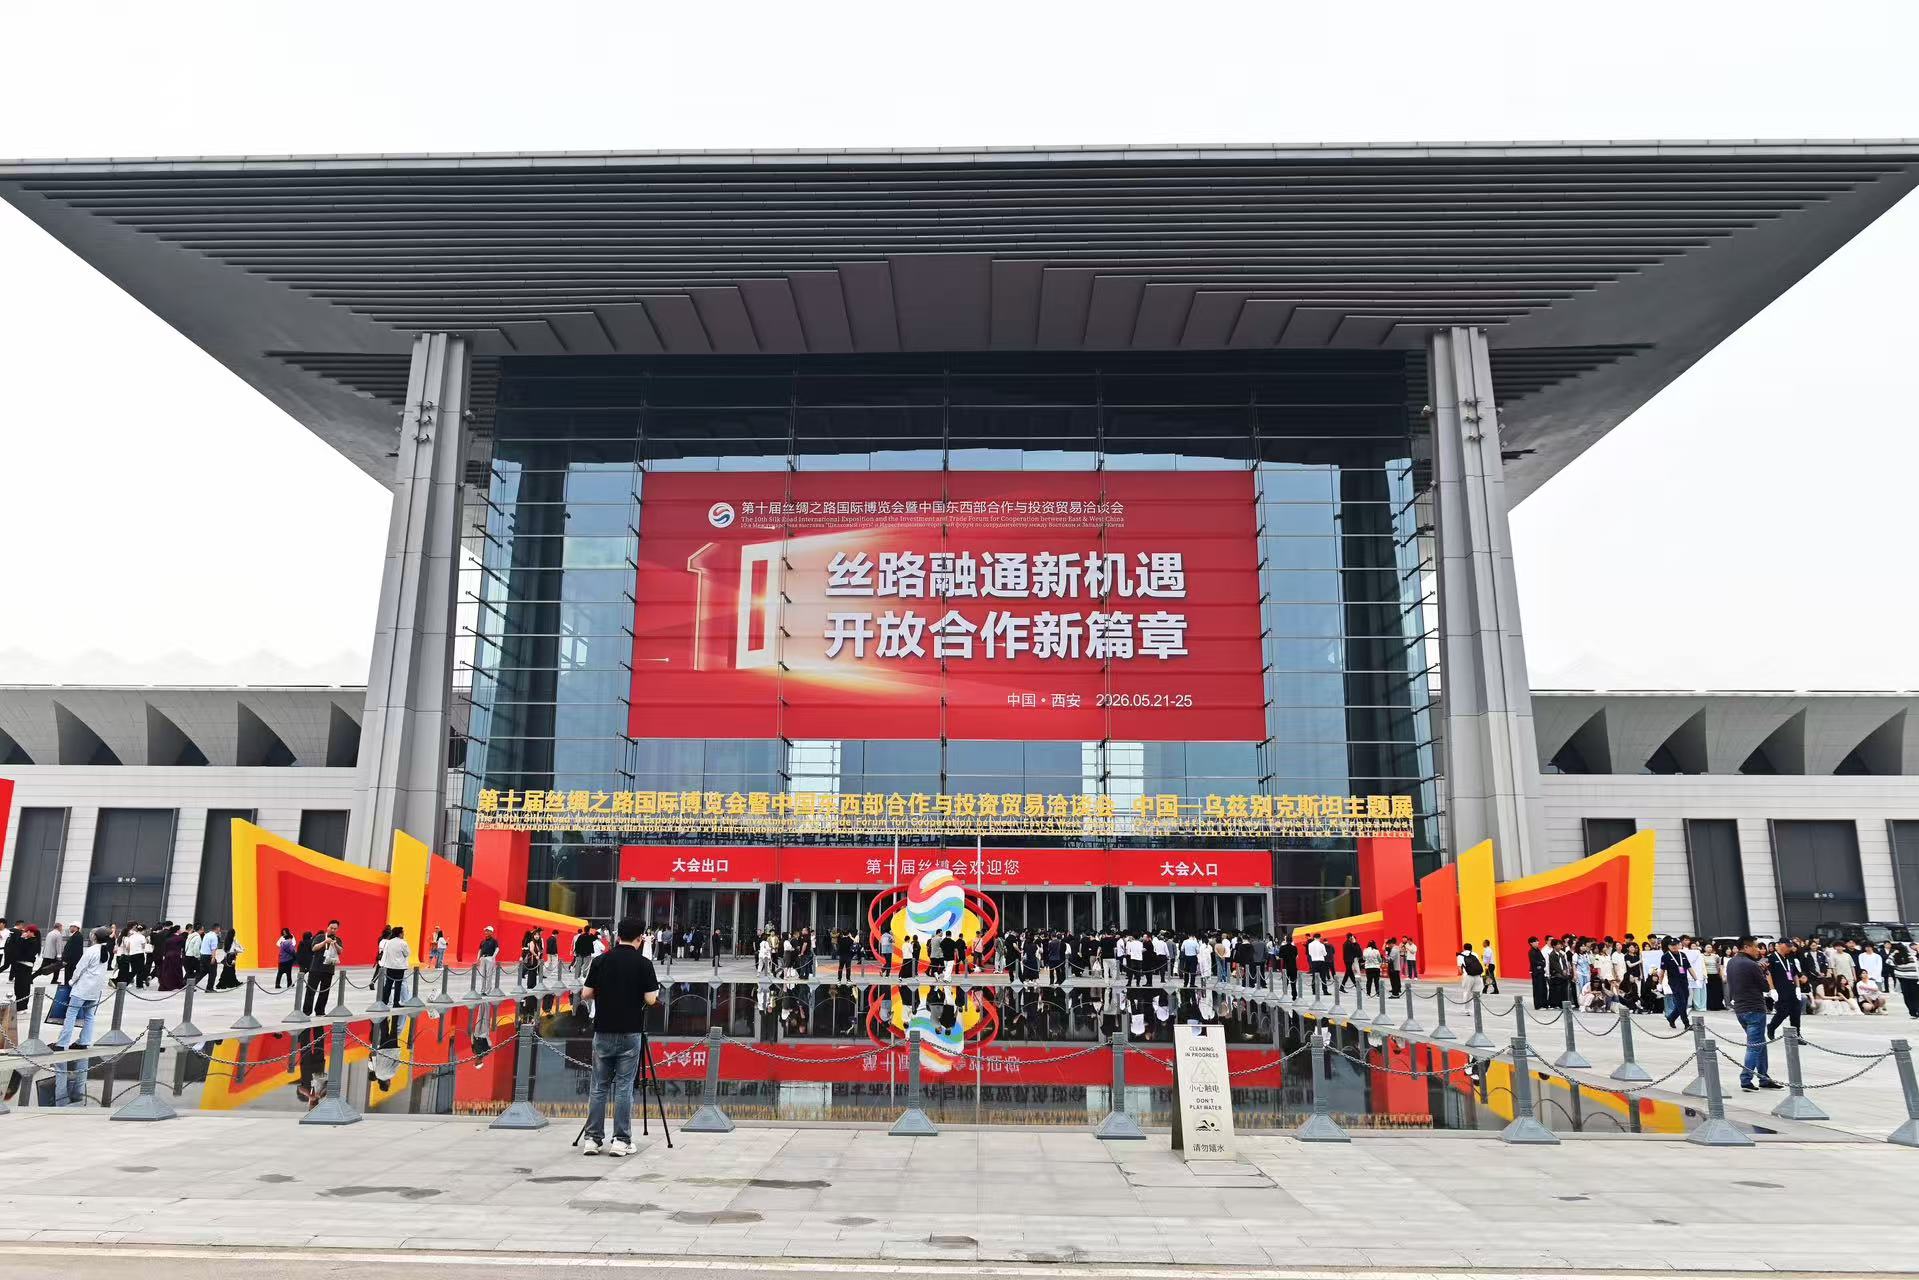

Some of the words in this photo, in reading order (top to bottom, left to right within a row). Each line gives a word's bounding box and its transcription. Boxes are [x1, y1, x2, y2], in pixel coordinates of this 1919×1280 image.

[741, 501, 1124, 515] 第十届丝绸之路国际博览会暨中国东西部合作与投资贸易洽谈会
[825, 550, 1187, 599] 丝路融通新机遇
[824, 610, 1189, 660] 开放合作新篇章
[1096, 694, 1192, 708] 2026.05.21-25
[478, 789, 1115, 817] 第十届丝绸之路国际博览会暨中国东西部合作与投资贸易洽谈会
[856, 817, 886, 826] Forum
[891, 817, 906, 826] for
[672, 858, 728, 872] 大会出口
[1160, 862, 1218, 876] 大会入口
[1189, 1084, 1220, 1094] 小心触电
[1193, 1144, 1225, 1153] 请勿嬉水
